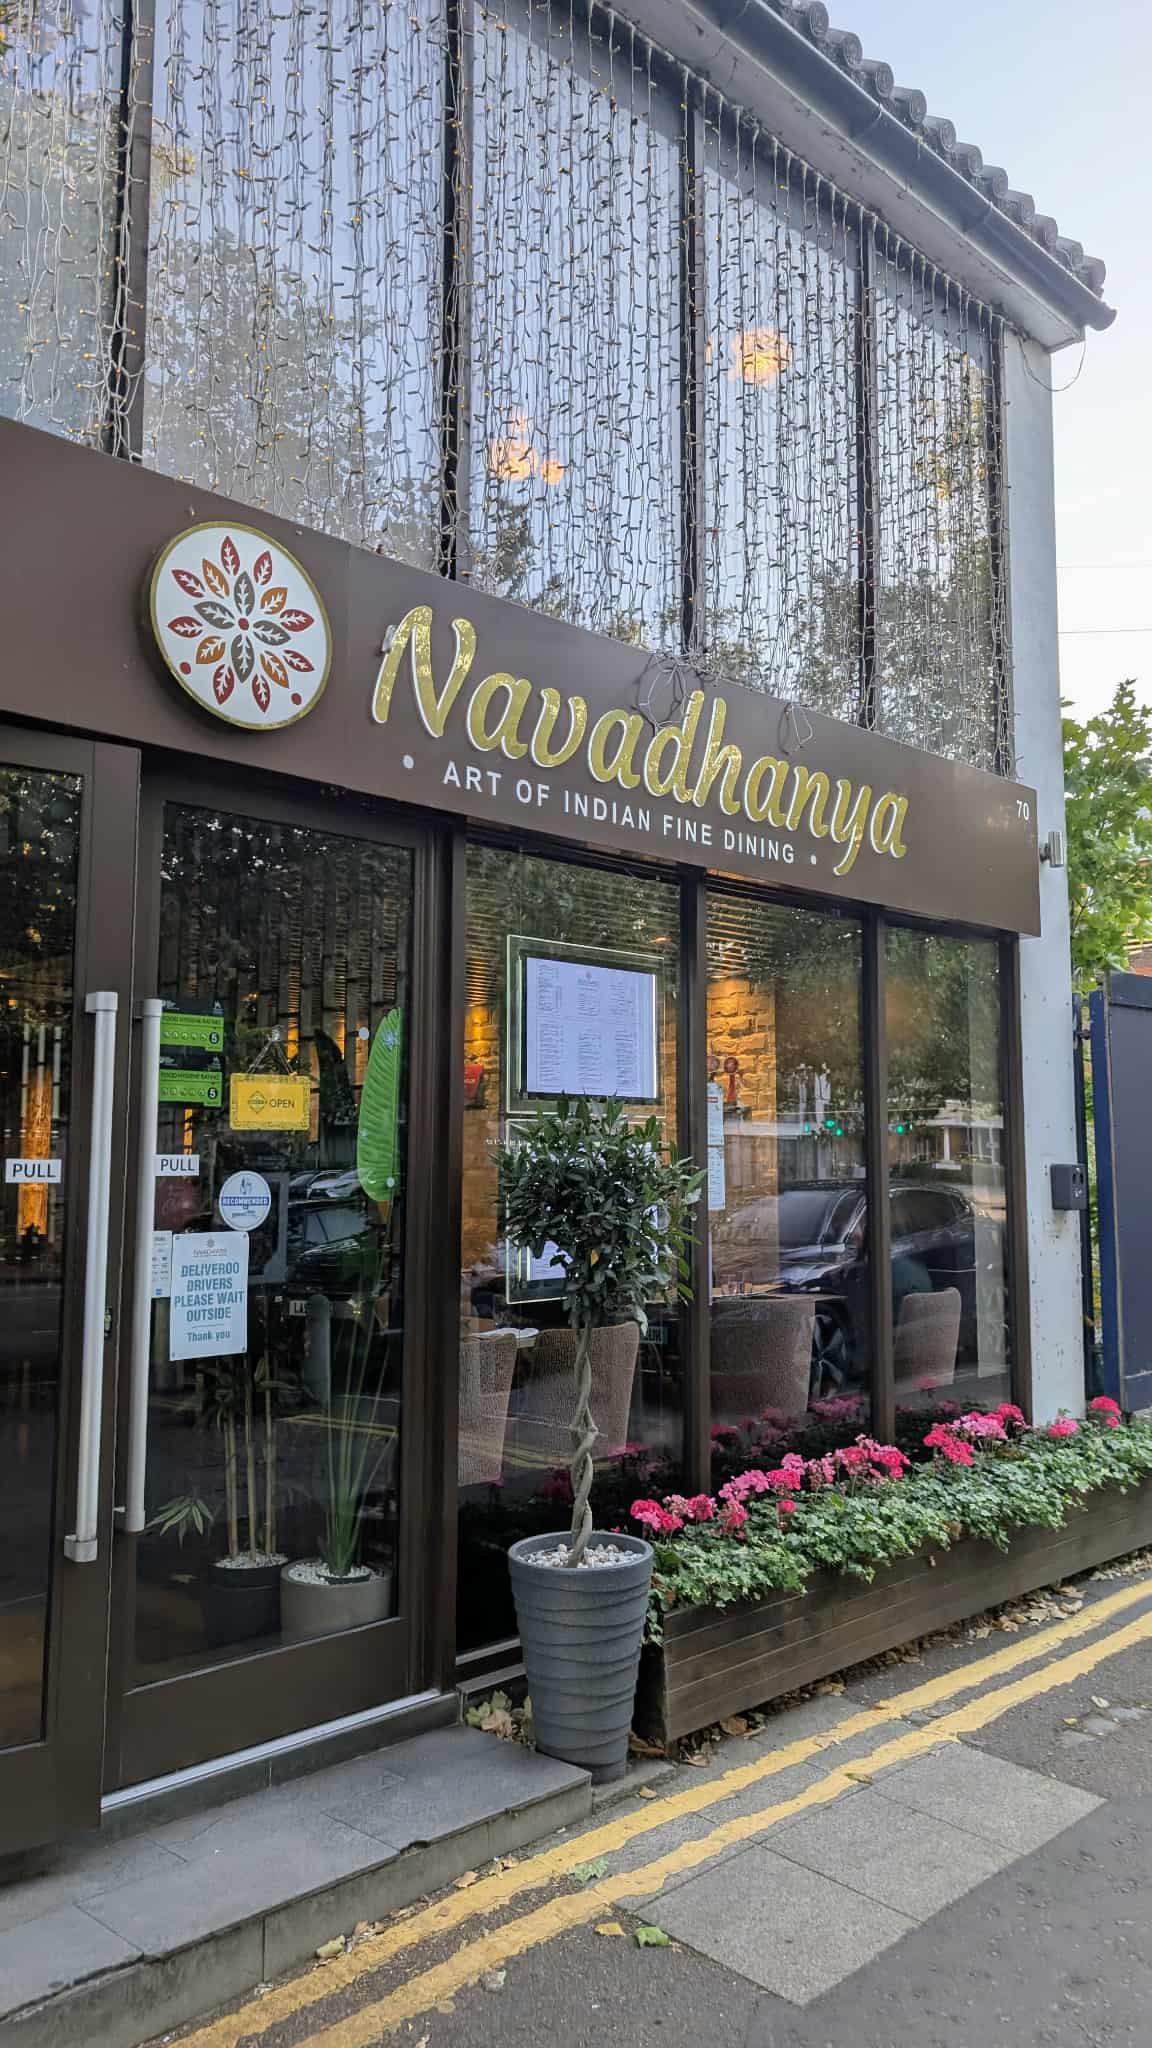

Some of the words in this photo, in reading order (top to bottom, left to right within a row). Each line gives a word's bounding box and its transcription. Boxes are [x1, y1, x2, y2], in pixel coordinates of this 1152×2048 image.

[371, 604, 909, 876] Navadhanya
[443, 760, 502, 797] ART
[516, 778, 550, 808] OF
[563, 789, 652, 832] INDIAN
[663, 814, 713, 846] FINE
[724, 828, 795, 864] DINING
[1016, 799, 1030, 821] 70
[211, 1032, 218, 1044] 5
[209, 1087, 216, 1099] 5
[269, 1098, 295, 1109] OPEN
[12, 1163, 56, 1178] PULL
[160, 1158, 196, 1172] PULL
[181, 1261, 239, 1277] DELIVEROO
[187, 1277, 233, 1292] DRIVERS
[175, 1293, 214, 1308] PLEASE
[217, 1290, 244, 1305] WAIT
[186, 1307, 231, 1322] OUTSIDE
[187, 1331, 213, 1342] Thank
[215, 1331, 231, 1342] you
